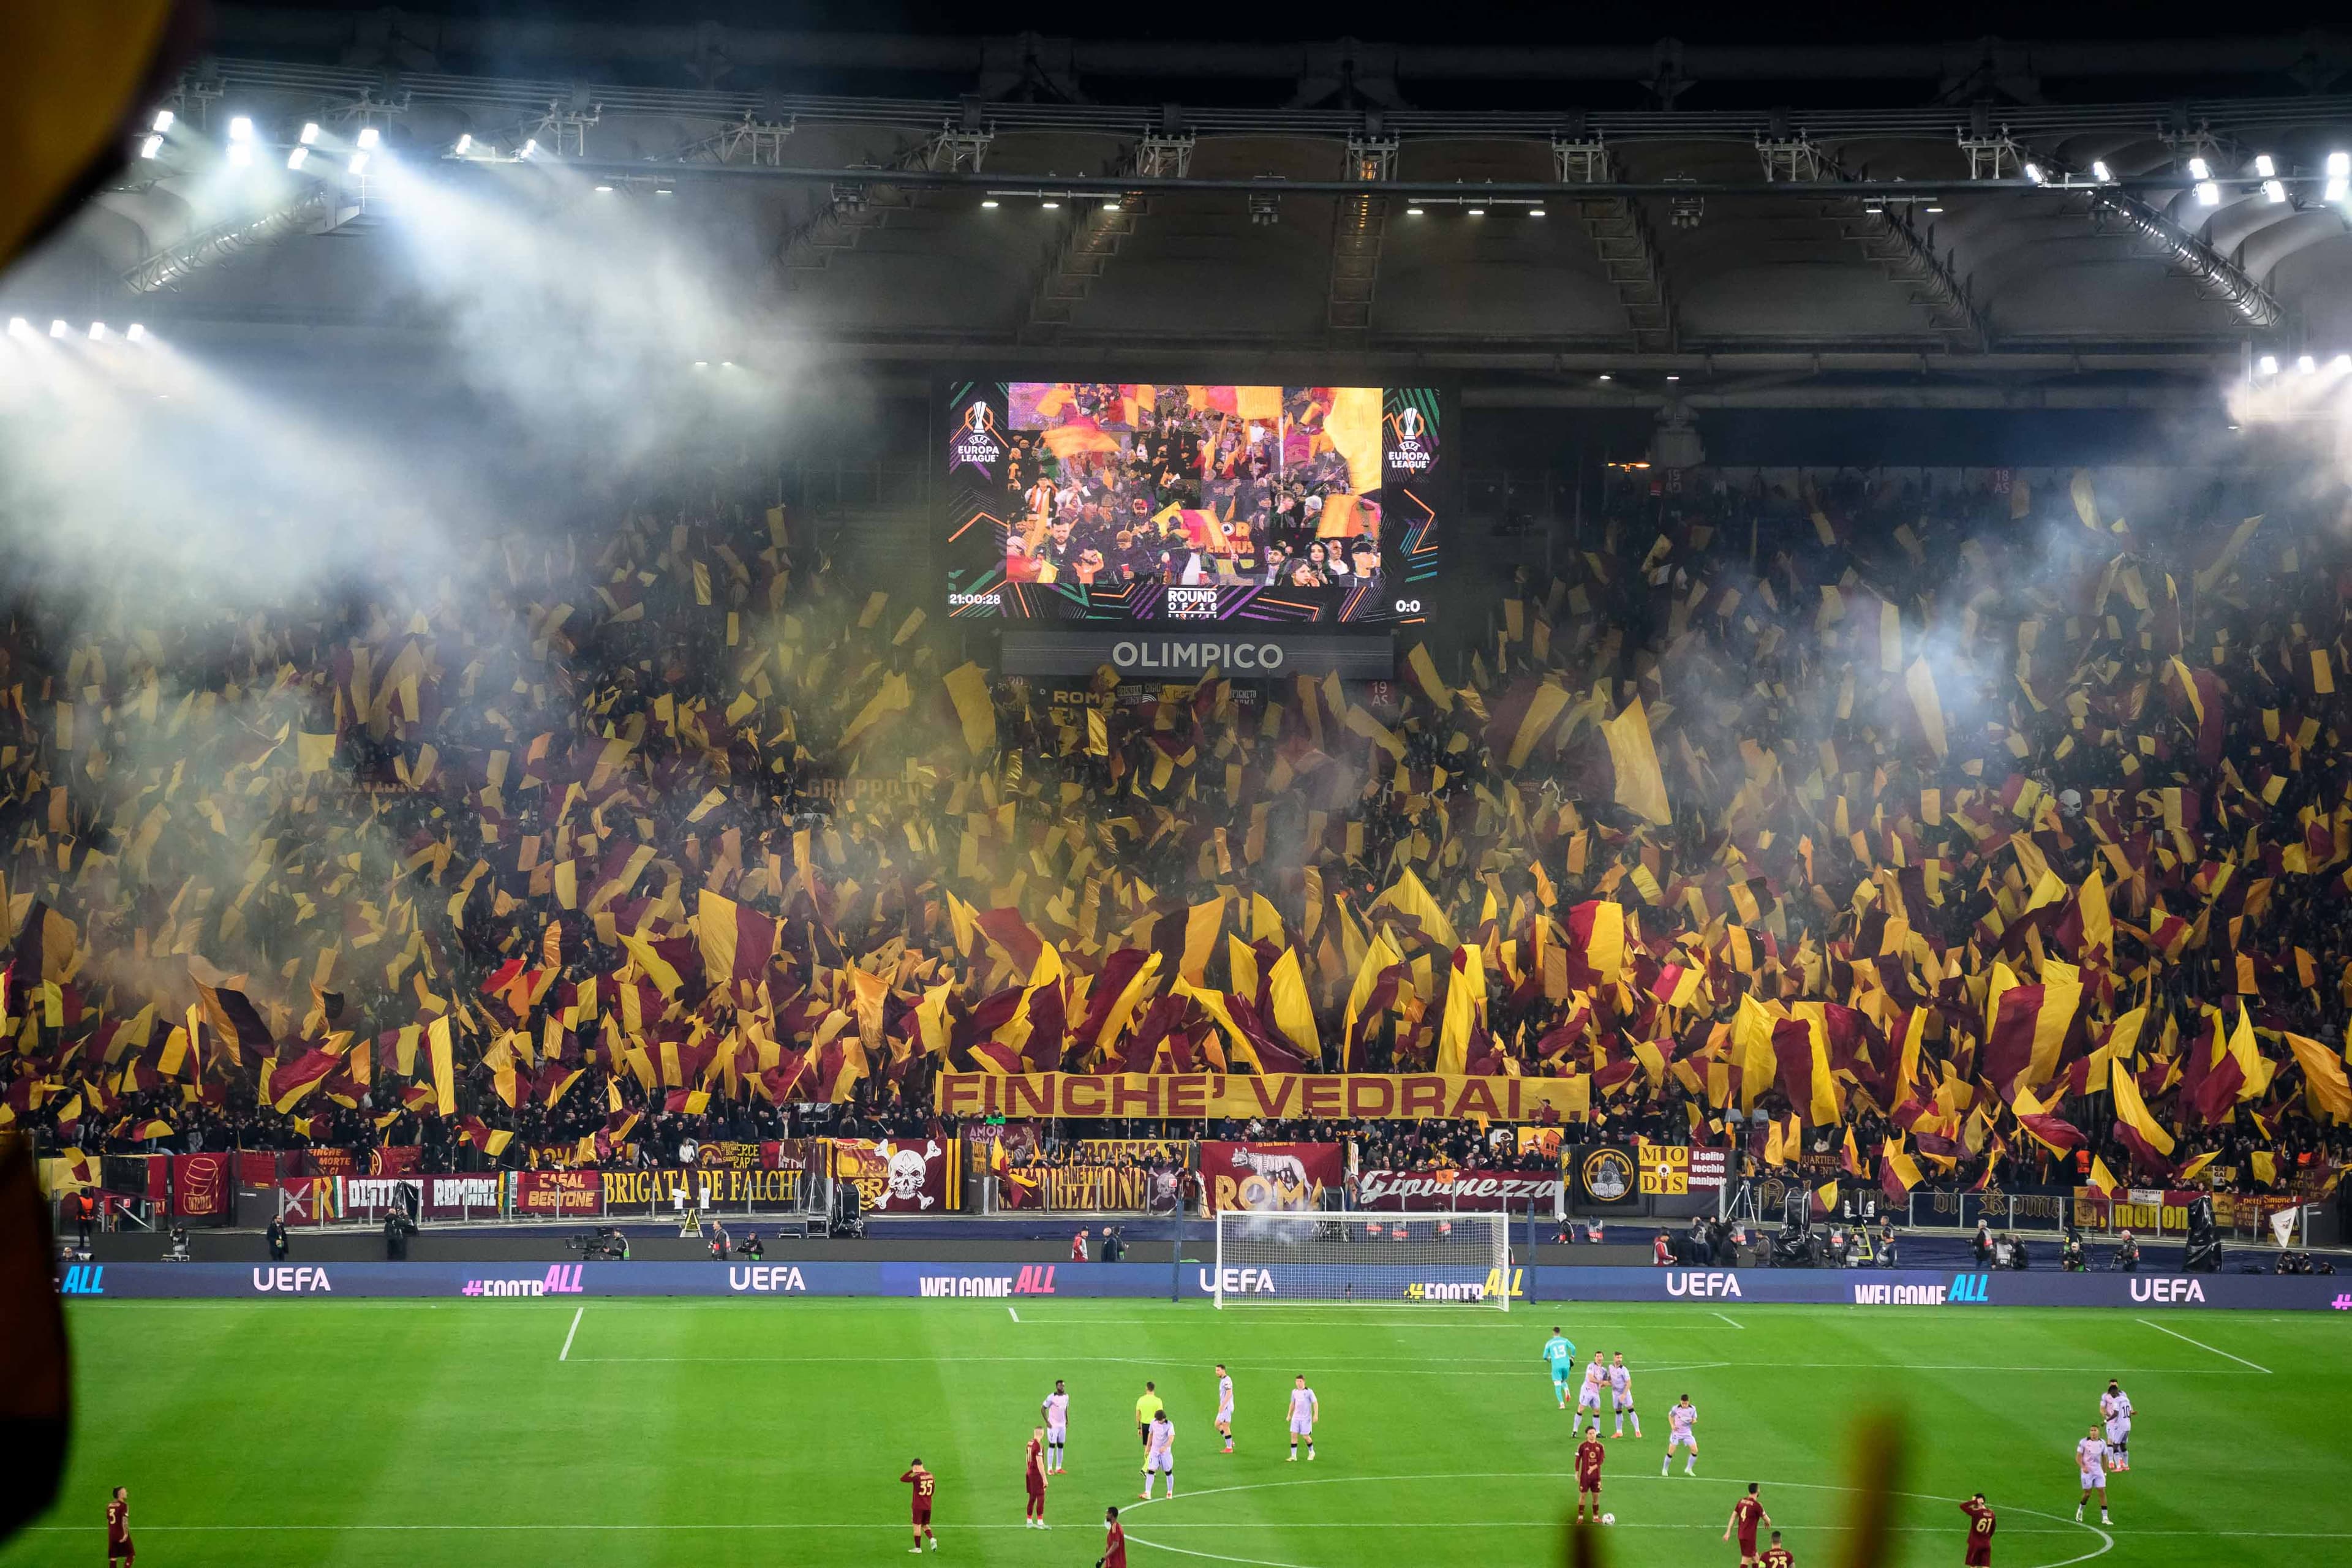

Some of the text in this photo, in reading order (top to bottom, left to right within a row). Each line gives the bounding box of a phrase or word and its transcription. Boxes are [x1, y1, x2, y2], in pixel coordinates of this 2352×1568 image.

[949, 594, 1001, 605] 21:00:28
[1168, 590, 1218, 602] ROUND
[1168, 602, 1188, 611] OF
[1395, 600, 1421, 612] 0:0
[1112, 642, 1284, 669] OLIMPICO
[1372, 681, 1387, 693] 19
[1371, 695, 1389, 706] AS
[943, 1074, 1226, 1116] FINCHE'
[970, 1126, 1005, 1137] AMOR
[319, 1157, 351, 1166] MORTE
[1700, 1152, 1725, 1161] solito
[1692, 1162, 1725, 1173] vecchio
[539, 1174, 586, 1189] CASAL
[601, 1169, 803, 1204] BRIGATA DE FALCHI
[1360, 1170, 1556, 1204] Giovinezza
[433, 1179, 497, 1207] ROMANI
[527, 1191, 594, 1207] BERTONE
[2264, 1194, 2291, 1204] Simone
[62, 1265, 104, 1294] ALL
[254, 1267, 331, 1291] UEFA
[729, 1267, 806, 1291] UEFA
[1014, 1265, 1055, 1294] ALL
[1200, 1268, 1275, 1293] UEFA
[1667, 1272, 1742, 1297] UEFA
[1948, 1274, 1989, 1302] ALL
[2130, 1278, 2206, 1303] UEFA
[1553, 1345, 1567, 1359] 13
[2122, 1405, 2130, 1419] 10
[919, 1480, 933, 1496] 35
[109, 1508, 116, 1525] 3
[1740, 1506, 1747, 1522] 4
[1977, 1518, 1992, 1534] 61
[1769, 1556, 1788, 1568] 23
